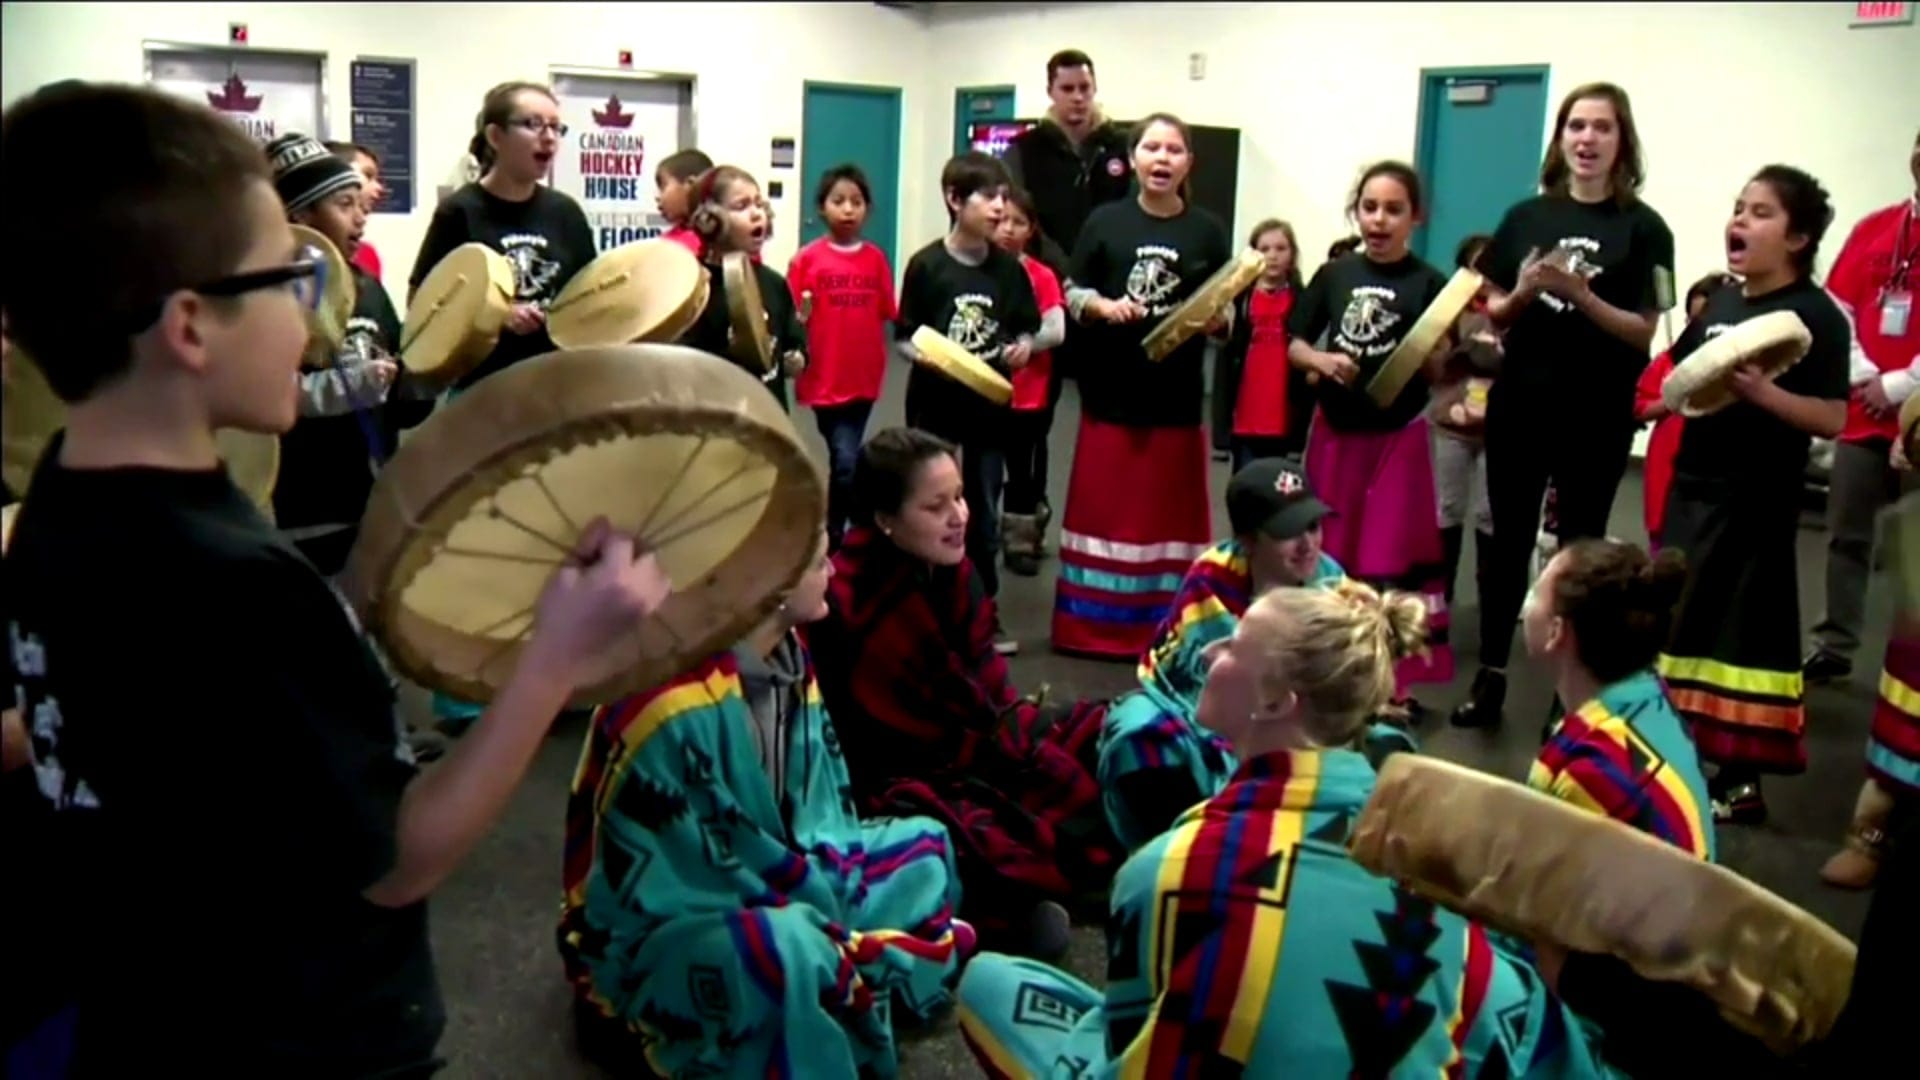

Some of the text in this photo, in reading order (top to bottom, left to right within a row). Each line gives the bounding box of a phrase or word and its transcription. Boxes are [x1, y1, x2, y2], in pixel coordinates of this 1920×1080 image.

[579, 133, 644, 151] CANADIAN
[580, 151, 644, 175] HOCKEY
[585, 177, 637, 200] HOUSE
